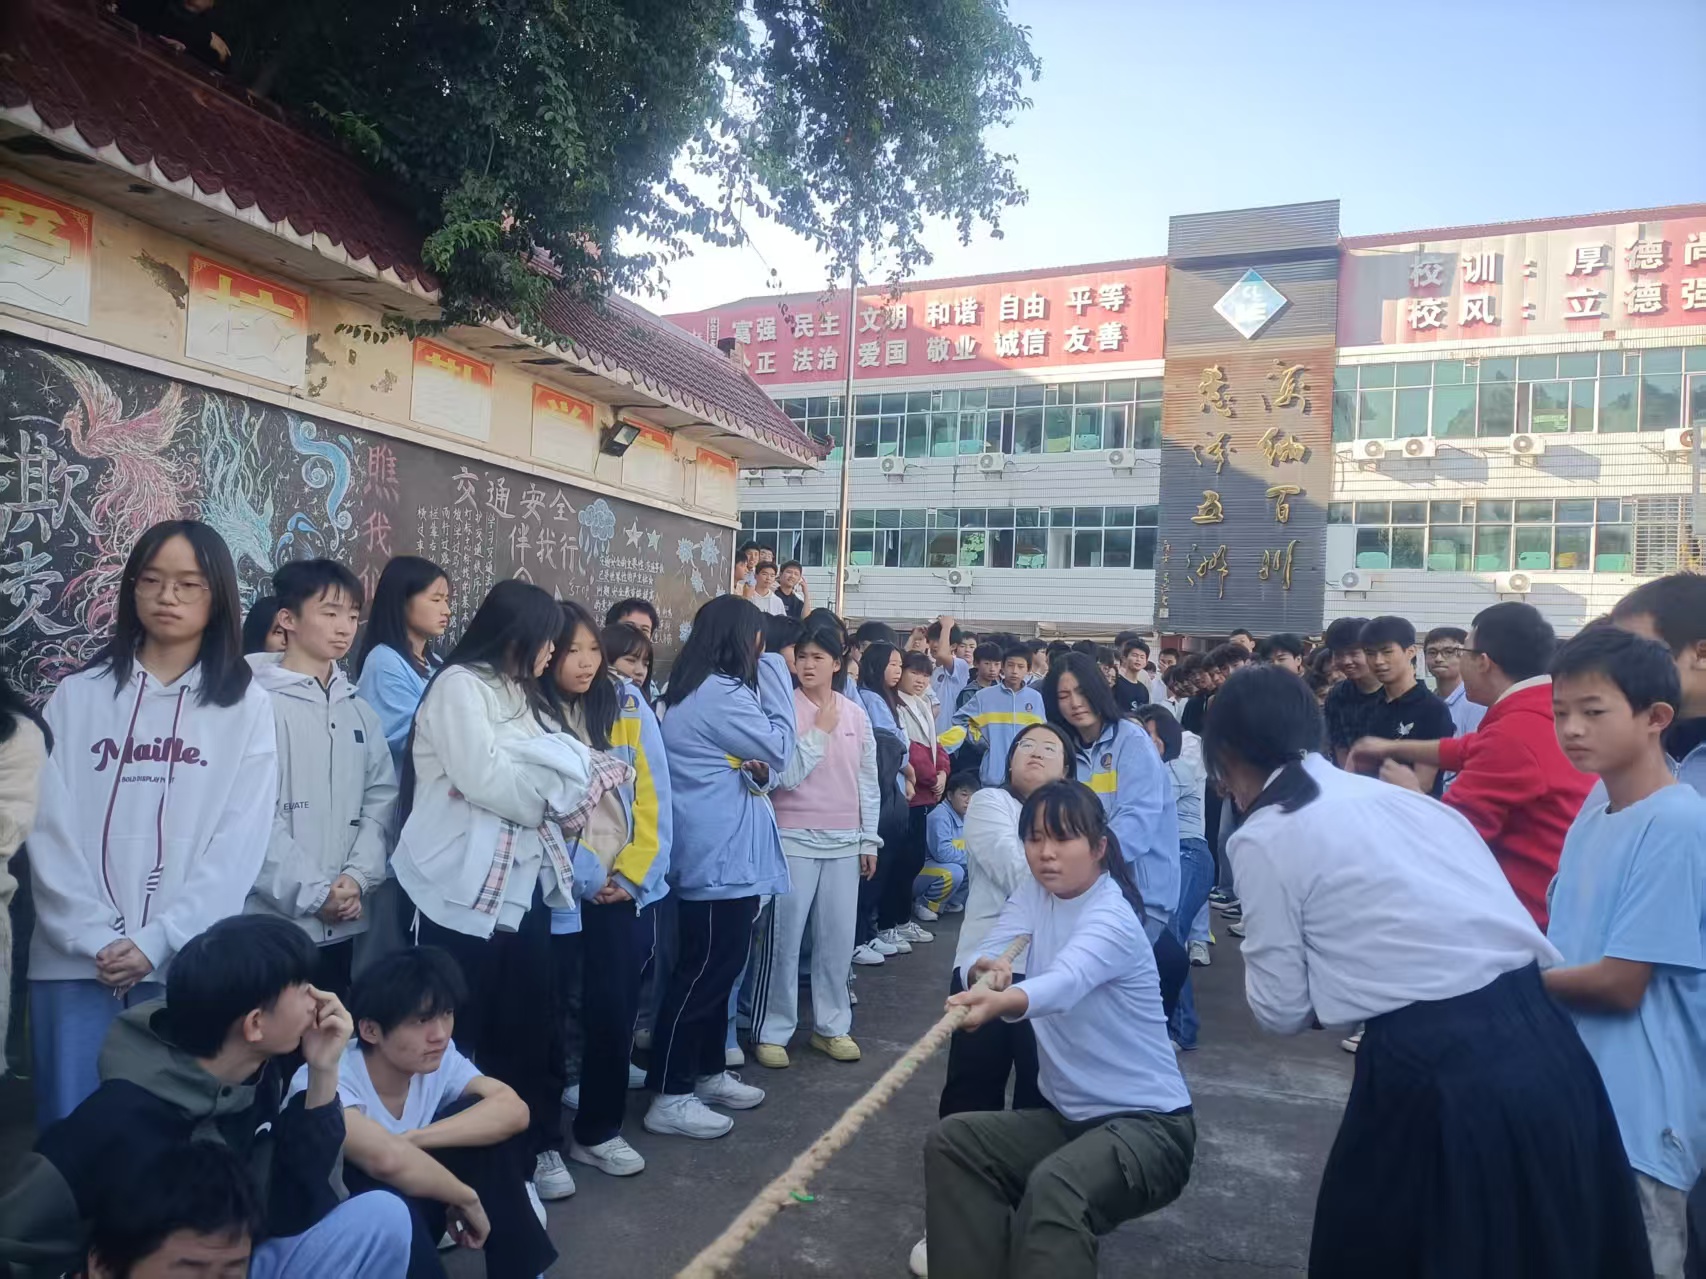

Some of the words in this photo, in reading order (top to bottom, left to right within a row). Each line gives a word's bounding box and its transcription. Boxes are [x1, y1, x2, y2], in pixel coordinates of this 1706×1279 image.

[732, 317, 777, 344] 富强
[793, 311, 840, 338] 民主
[859, 304, 908, 333] 文明
[927, 296, 980, 327] 和谐
[998, 292, 1046, 322] 自由
[1065, 283, 1126, 315] 平等
[743, 351, 776, 375] 正
[792, 347, 839, 372] 法治
[859, 337, 908, 368] 爱国
[927, 336, 977, 363] 敬业
[994, 327, 1047, 357] 诚信
[1063, 322, 1123, 353] 友善
[452, 466, 577, 523] 交通安全
[508, 523, 580, 574] 伴我行
